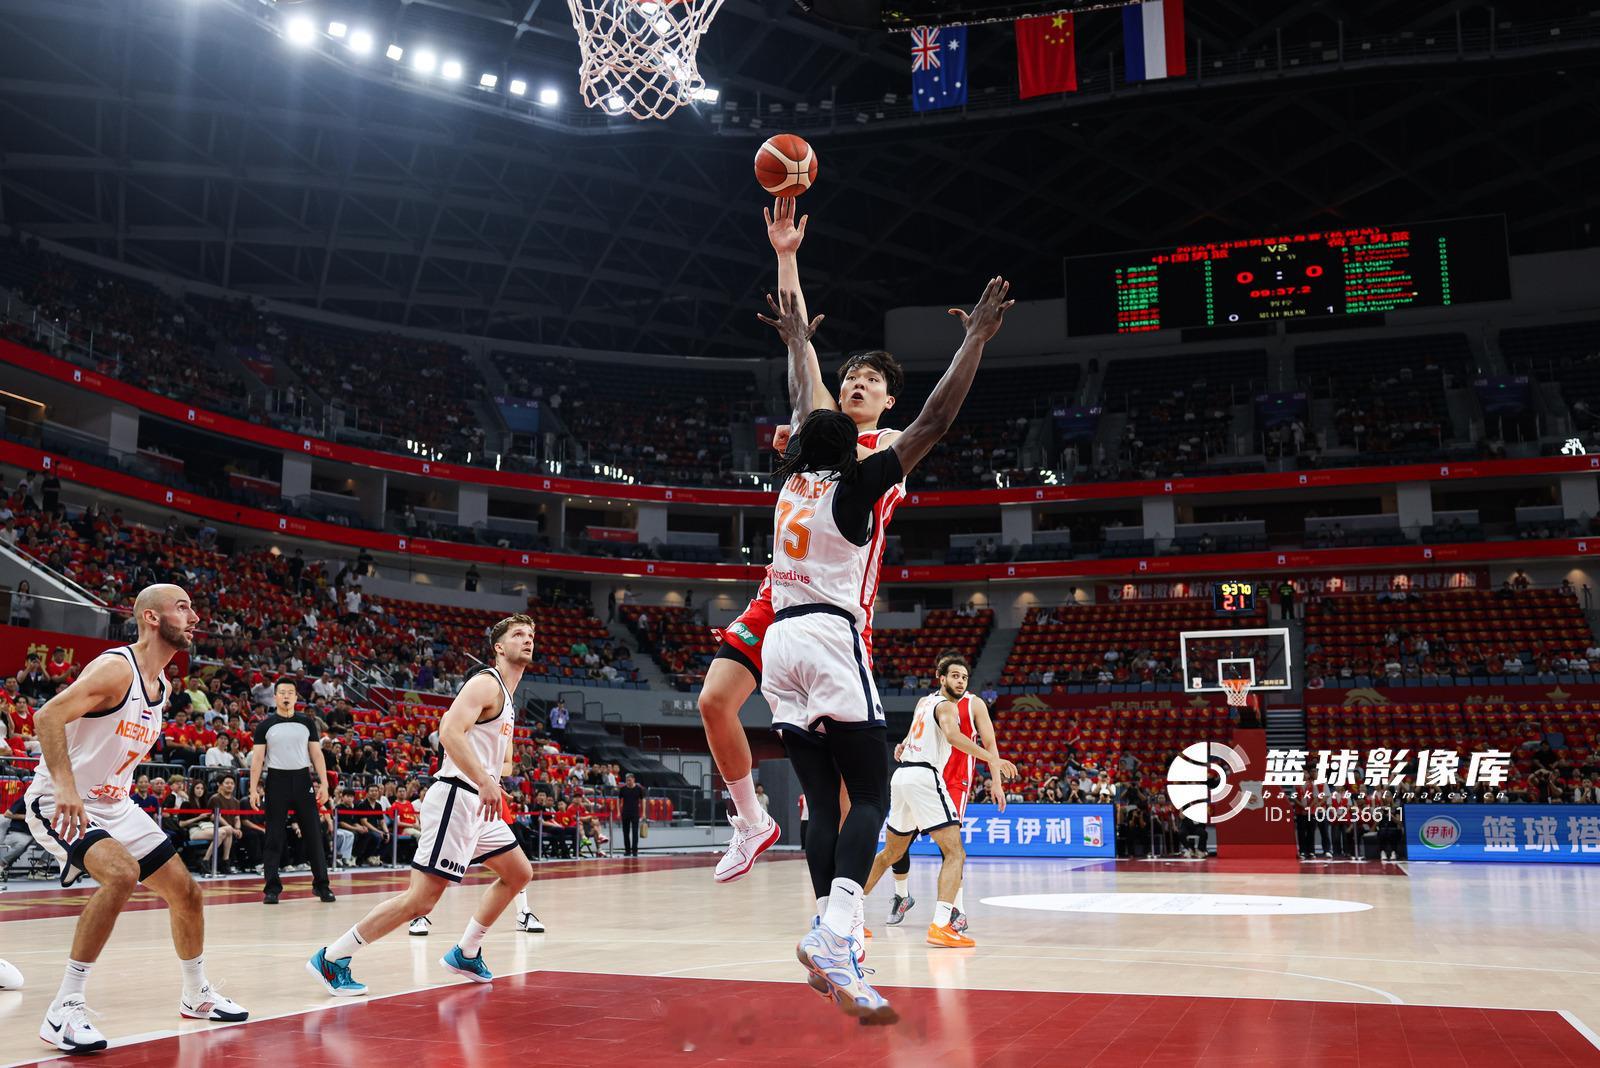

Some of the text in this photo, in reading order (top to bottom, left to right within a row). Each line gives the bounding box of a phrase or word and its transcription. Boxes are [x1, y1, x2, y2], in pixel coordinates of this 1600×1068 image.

[1267, 244, 1288, 253] VS
[1236, 271, 1254, 284] 0
[1305, 265, 1323, 278] 0
[1250, 285, 1312, 298] 09:37.2
[1327, 305, 1334, 313] 1
[1229, 314, 1239, 322] 0
[115, 750, 140, 775] 7
[1426, 826, 1453, 839] 伊利
[1482, 816, 1600, 853] 篮球搭
